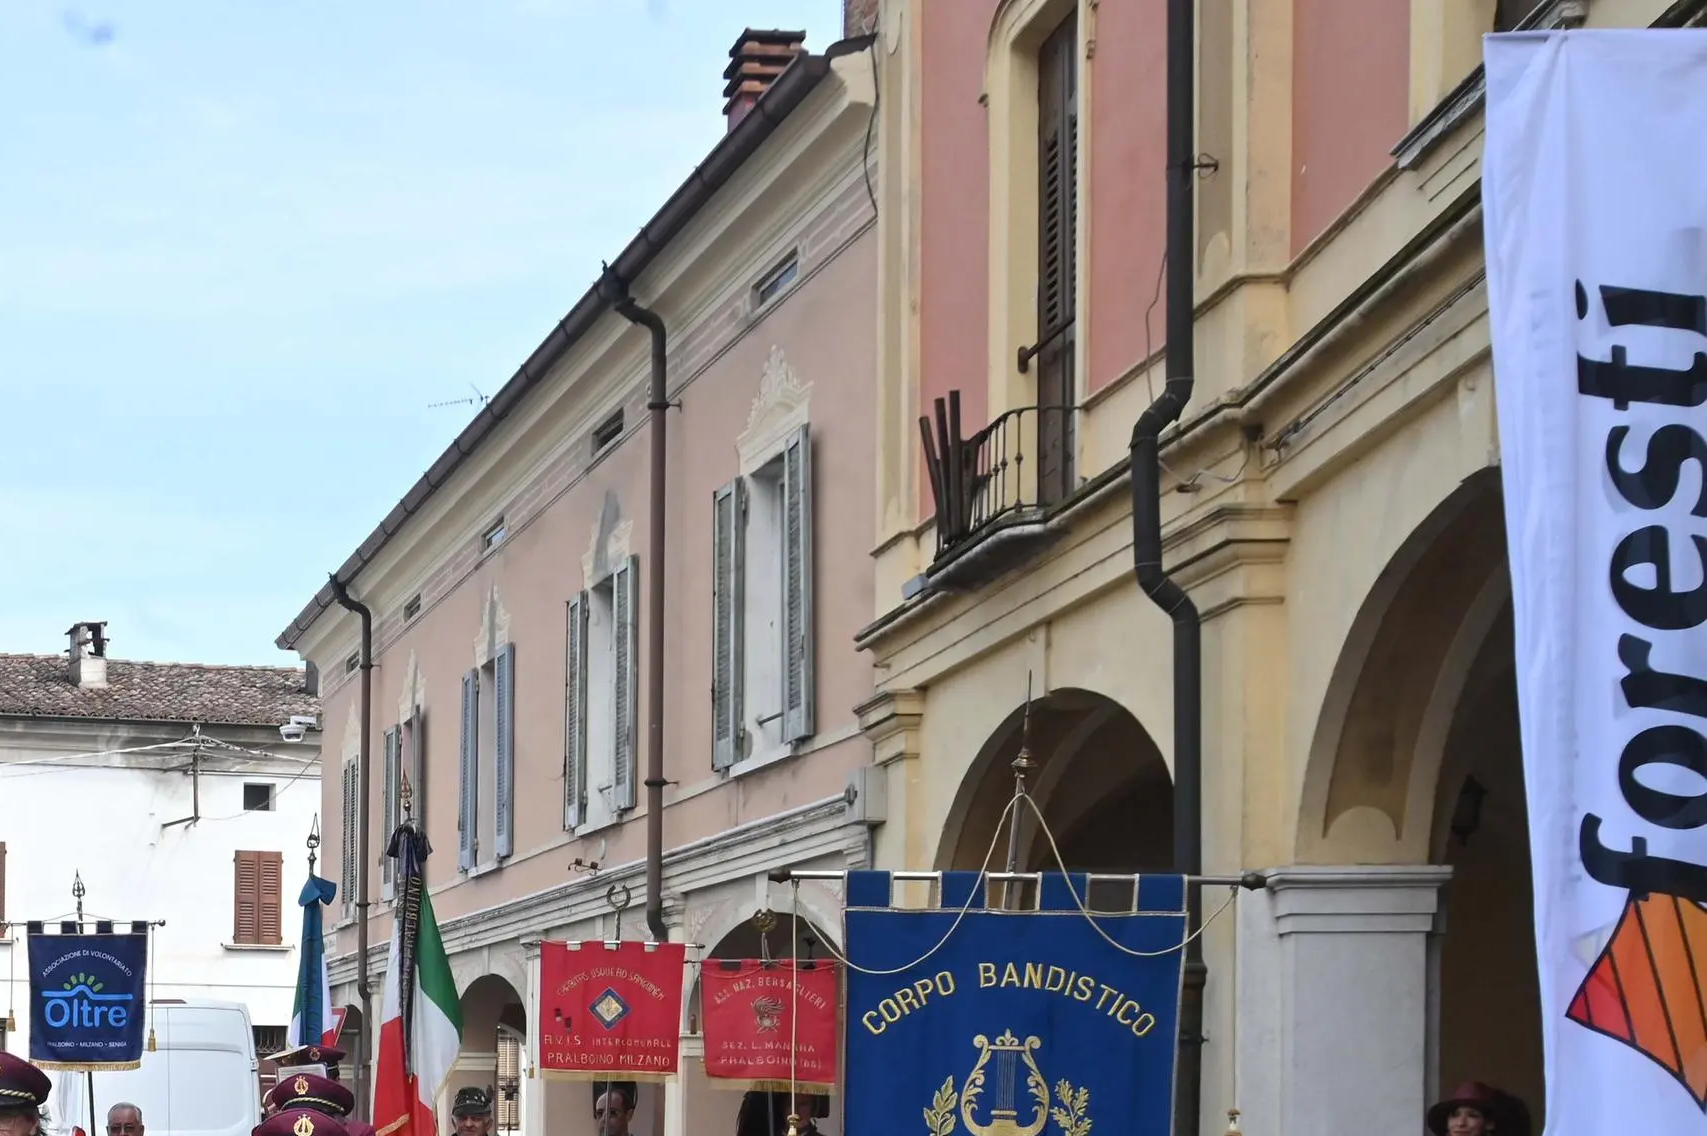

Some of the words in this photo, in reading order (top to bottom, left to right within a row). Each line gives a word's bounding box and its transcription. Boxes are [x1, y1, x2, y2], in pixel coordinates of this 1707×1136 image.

[1575, 278, 1707, 902] foresti
[43, 950, 82, 978] ASSOCIAZIONE
[91, 951, 133, 977] VOLONTARIATO
[758, 977, 827, 1010] BERSAGLIERI
[862, 971, 957, 1036] CORPO
[978, 962, 1157, 1038] BANDISTICO
[45, 998, 127, 1028] Oltre
[547, 1052, 614, 1065] PRALBOINO
[619, 1054, 670, 1067] MILZANO
